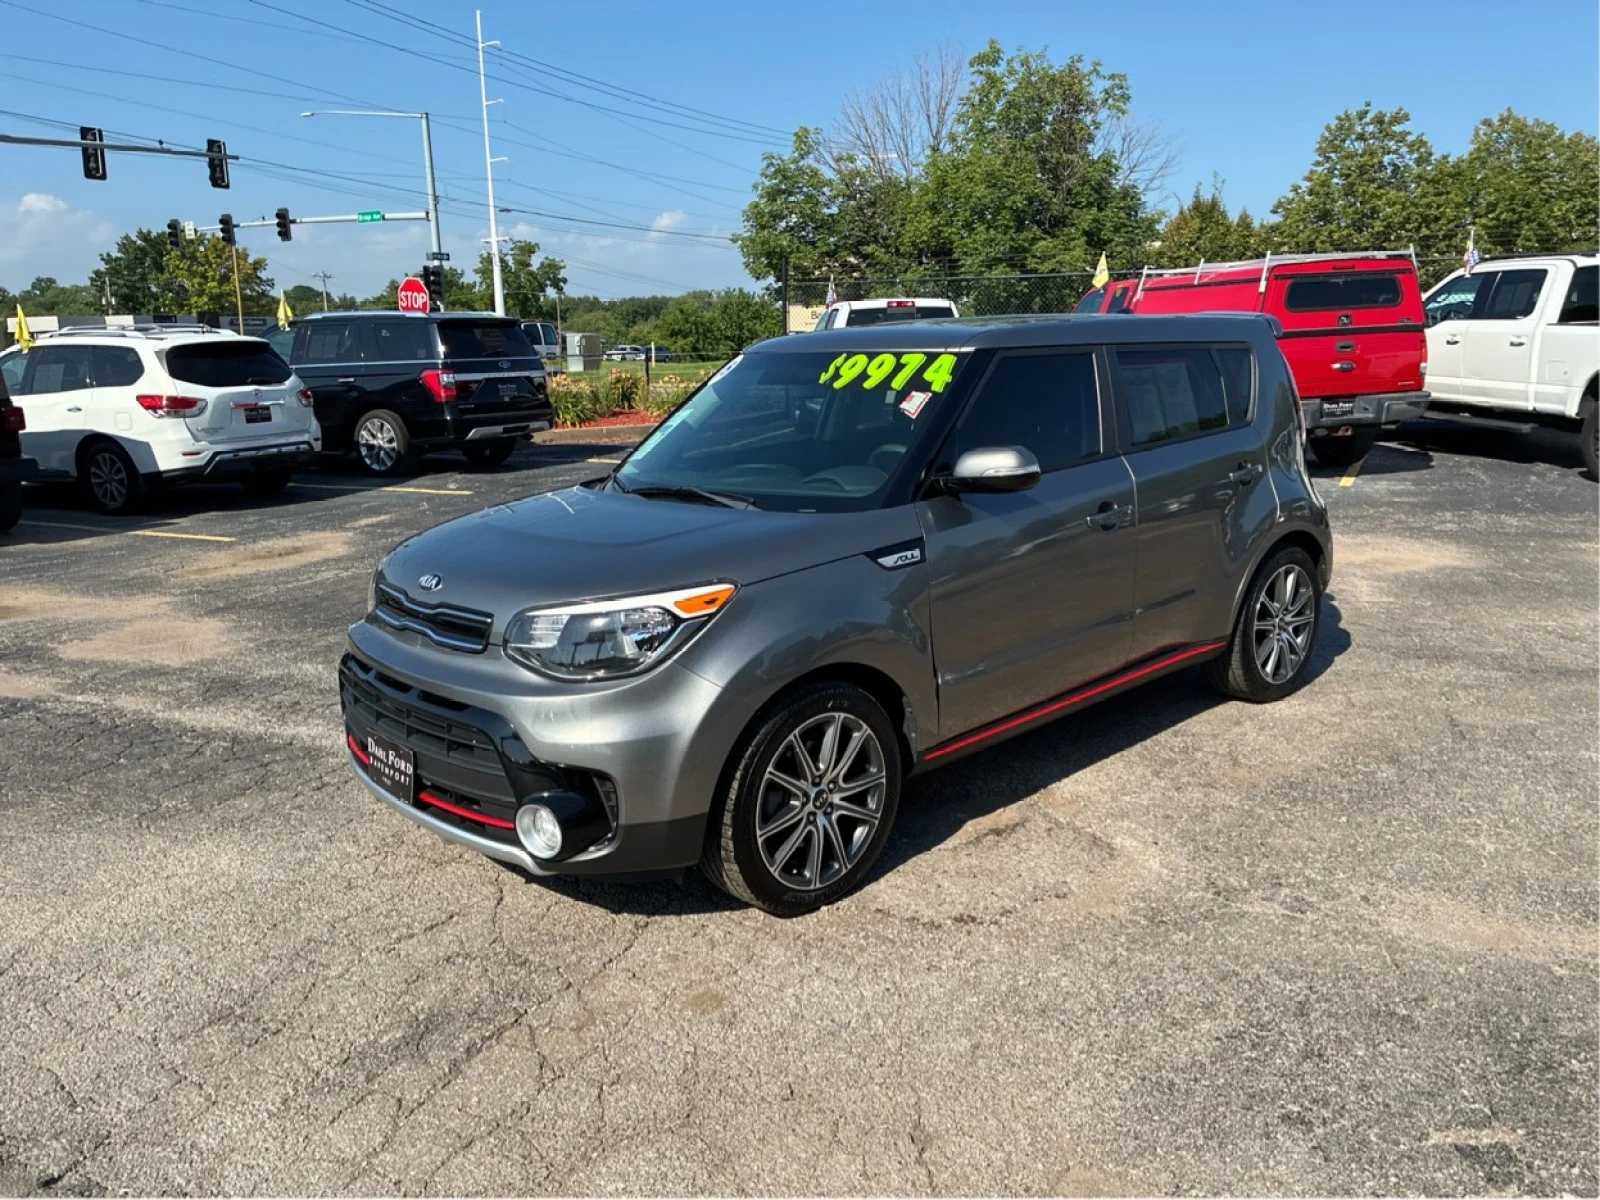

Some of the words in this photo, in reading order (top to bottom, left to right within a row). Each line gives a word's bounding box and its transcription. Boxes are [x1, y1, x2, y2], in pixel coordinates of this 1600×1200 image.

[400, 290, 427, 309] STOP
[818, 352, 957, 393] $9974
[892, 552, 920, 565] SOUL
[418, 574, 440, 590] KIA
[367, 736, 387, 763] DAHL
[388, 750, 413, 774] FORD
[370, 755, 409, 786] DAVENPORT
